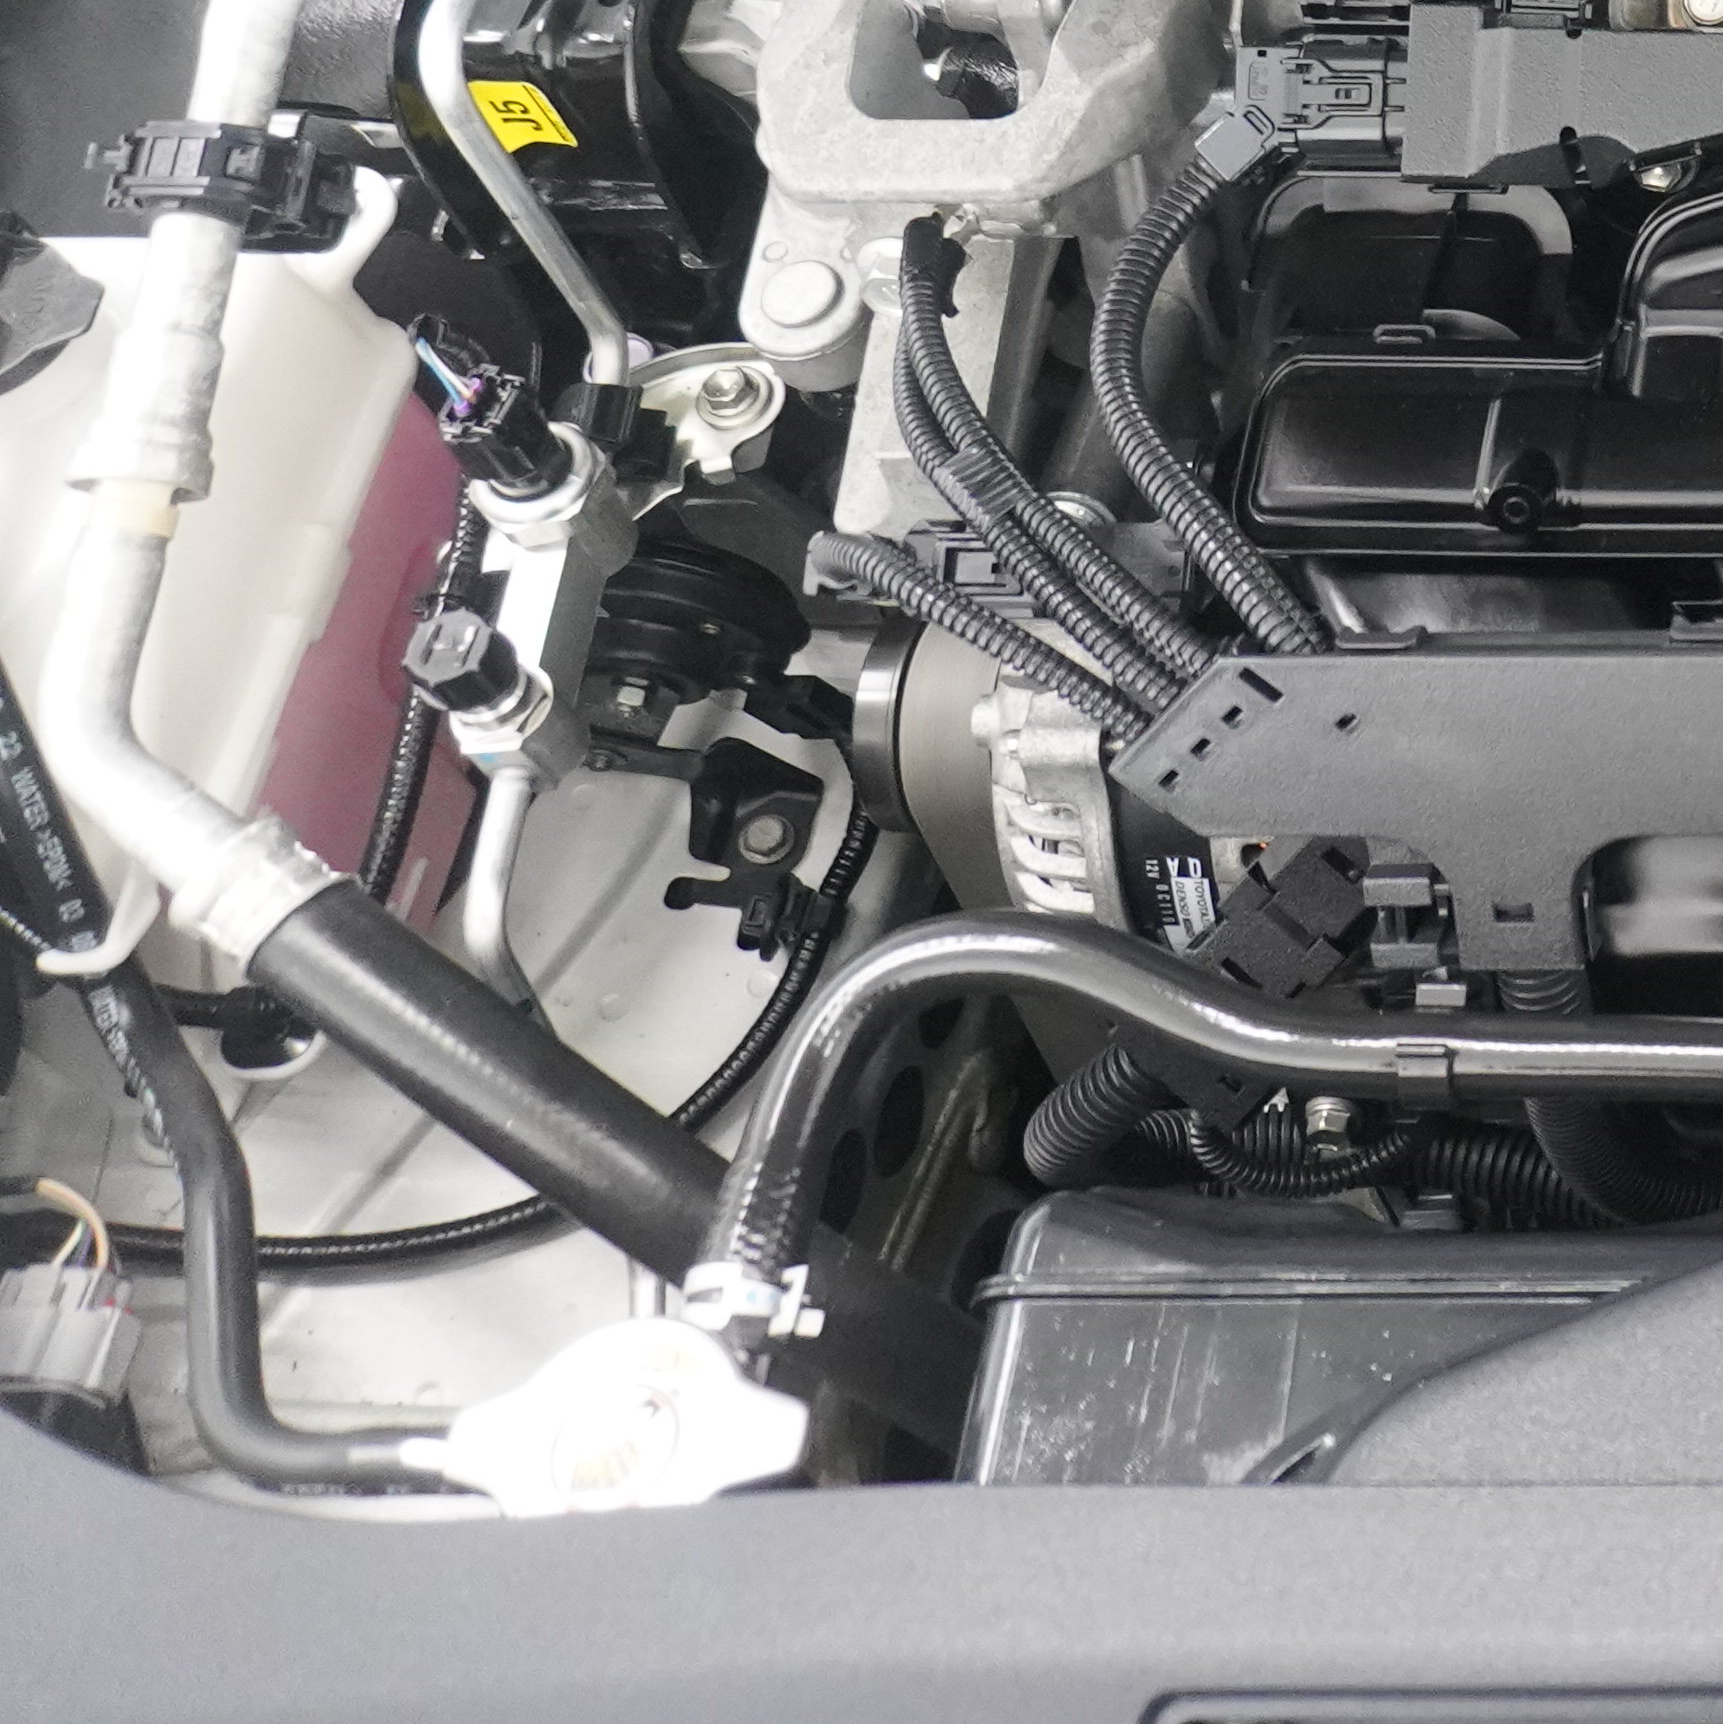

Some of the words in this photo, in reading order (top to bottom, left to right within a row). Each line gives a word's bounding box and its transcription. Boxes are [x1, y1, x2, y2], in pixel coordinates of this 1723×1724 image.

[489, 99, 542, 132] J5
[10, 767, 51, 830] WATER
[1145, 859, 1160, 878] 12V
[1175, 881, 1190, 916] DENSO
